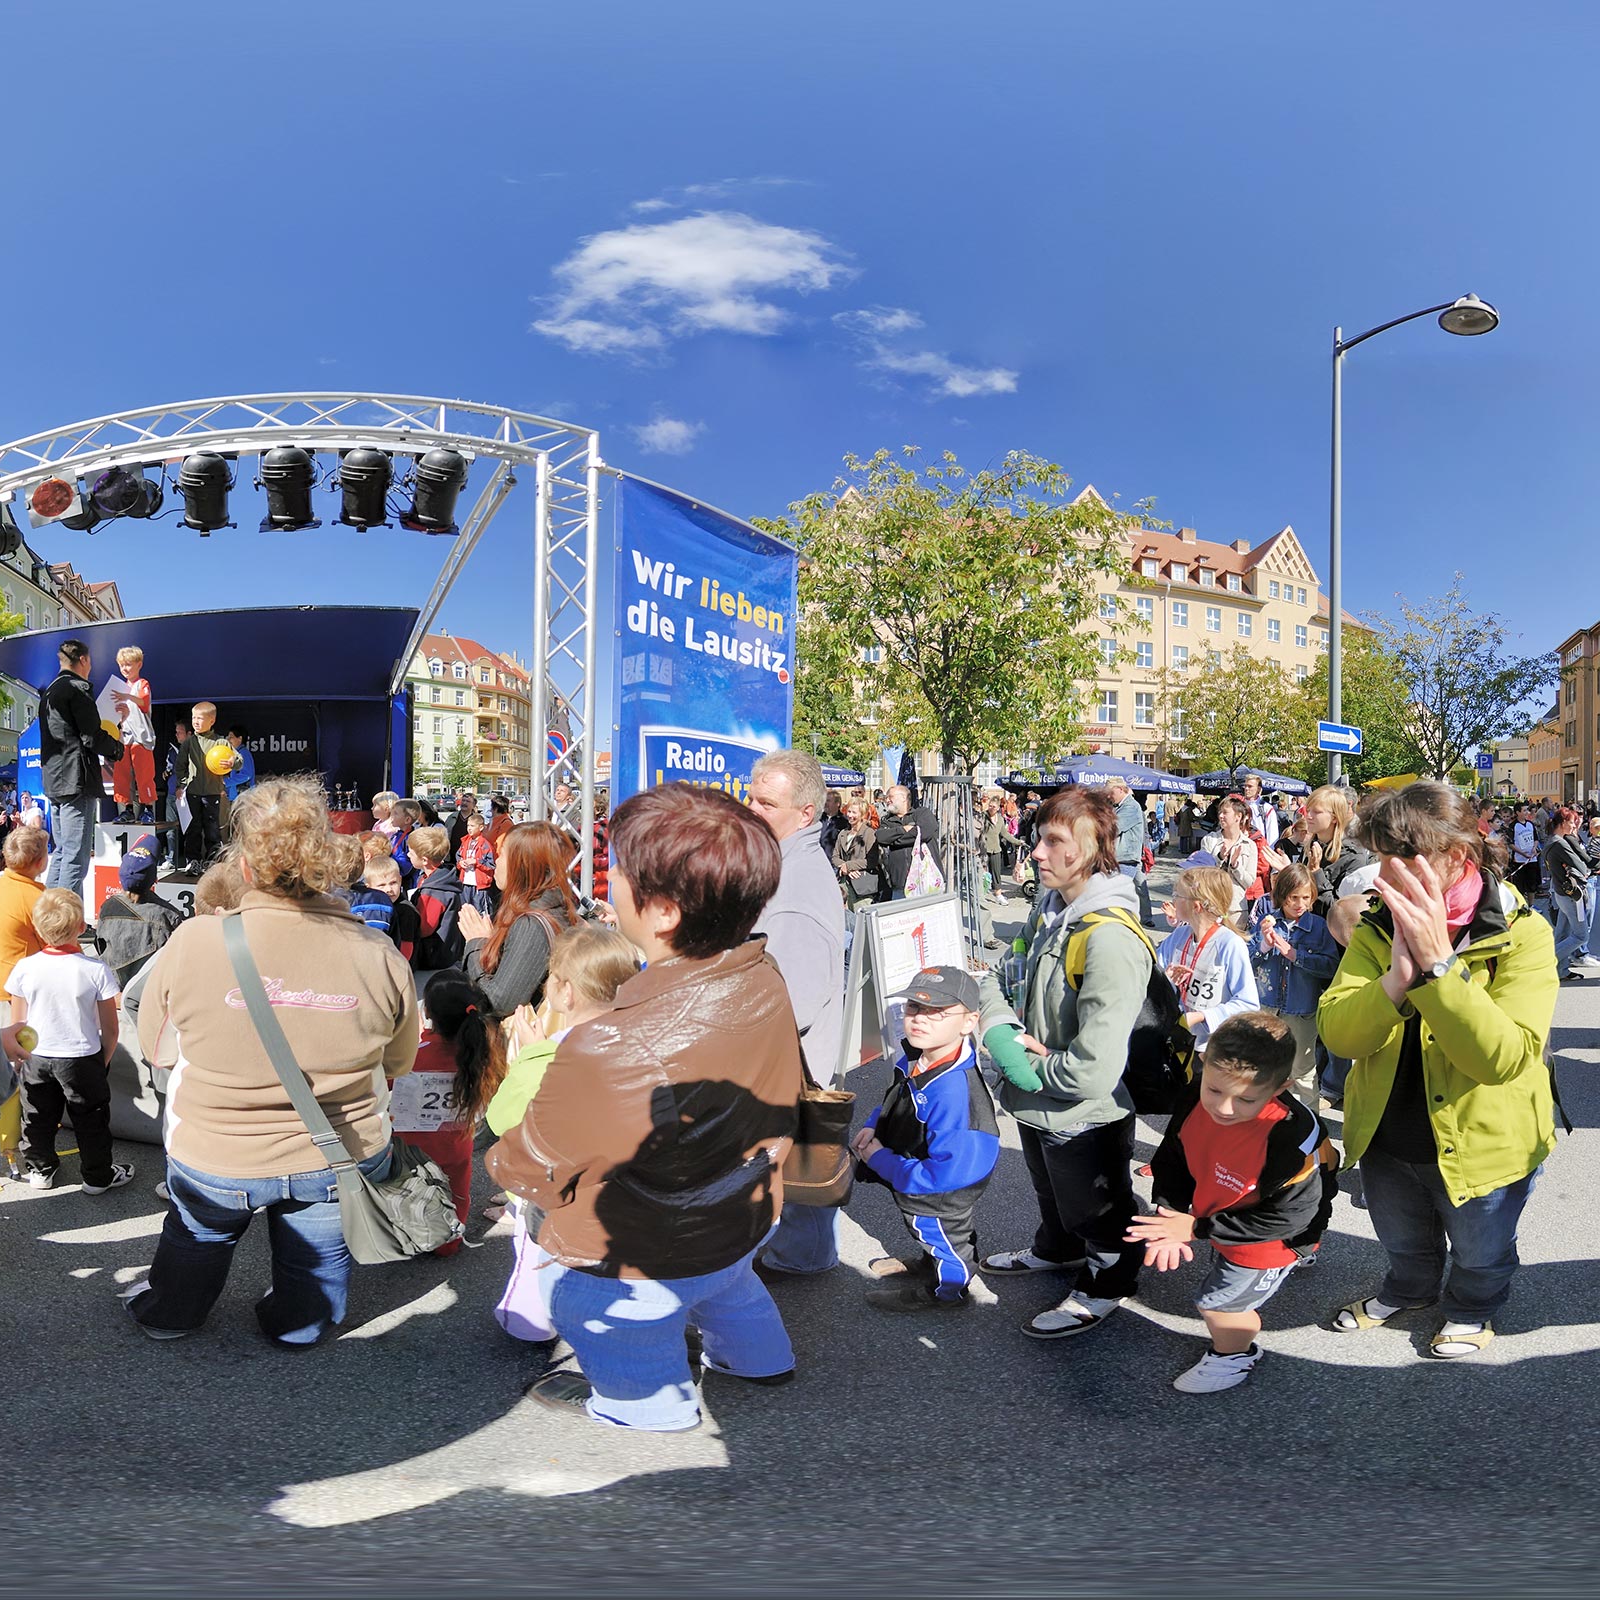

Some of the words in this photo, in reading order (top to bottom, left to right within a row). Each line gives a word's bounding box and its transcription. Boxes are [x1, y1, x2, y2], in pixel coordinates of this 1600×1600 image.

[631, 549, 693, 600] Wir
[699, 576, 783, 634] lieben
[626, 599, 676, 643] die
[685, 617, 787, 675] Lausitz
[246, 736, 266, 752] ist
[269, 735, 308, 752] blau
[665, 741, 726, 773] Radio
[1480, 756, 1489, 768] P
[116, 832, 128, 857] 1
[178, 890, 196, 920] 3
